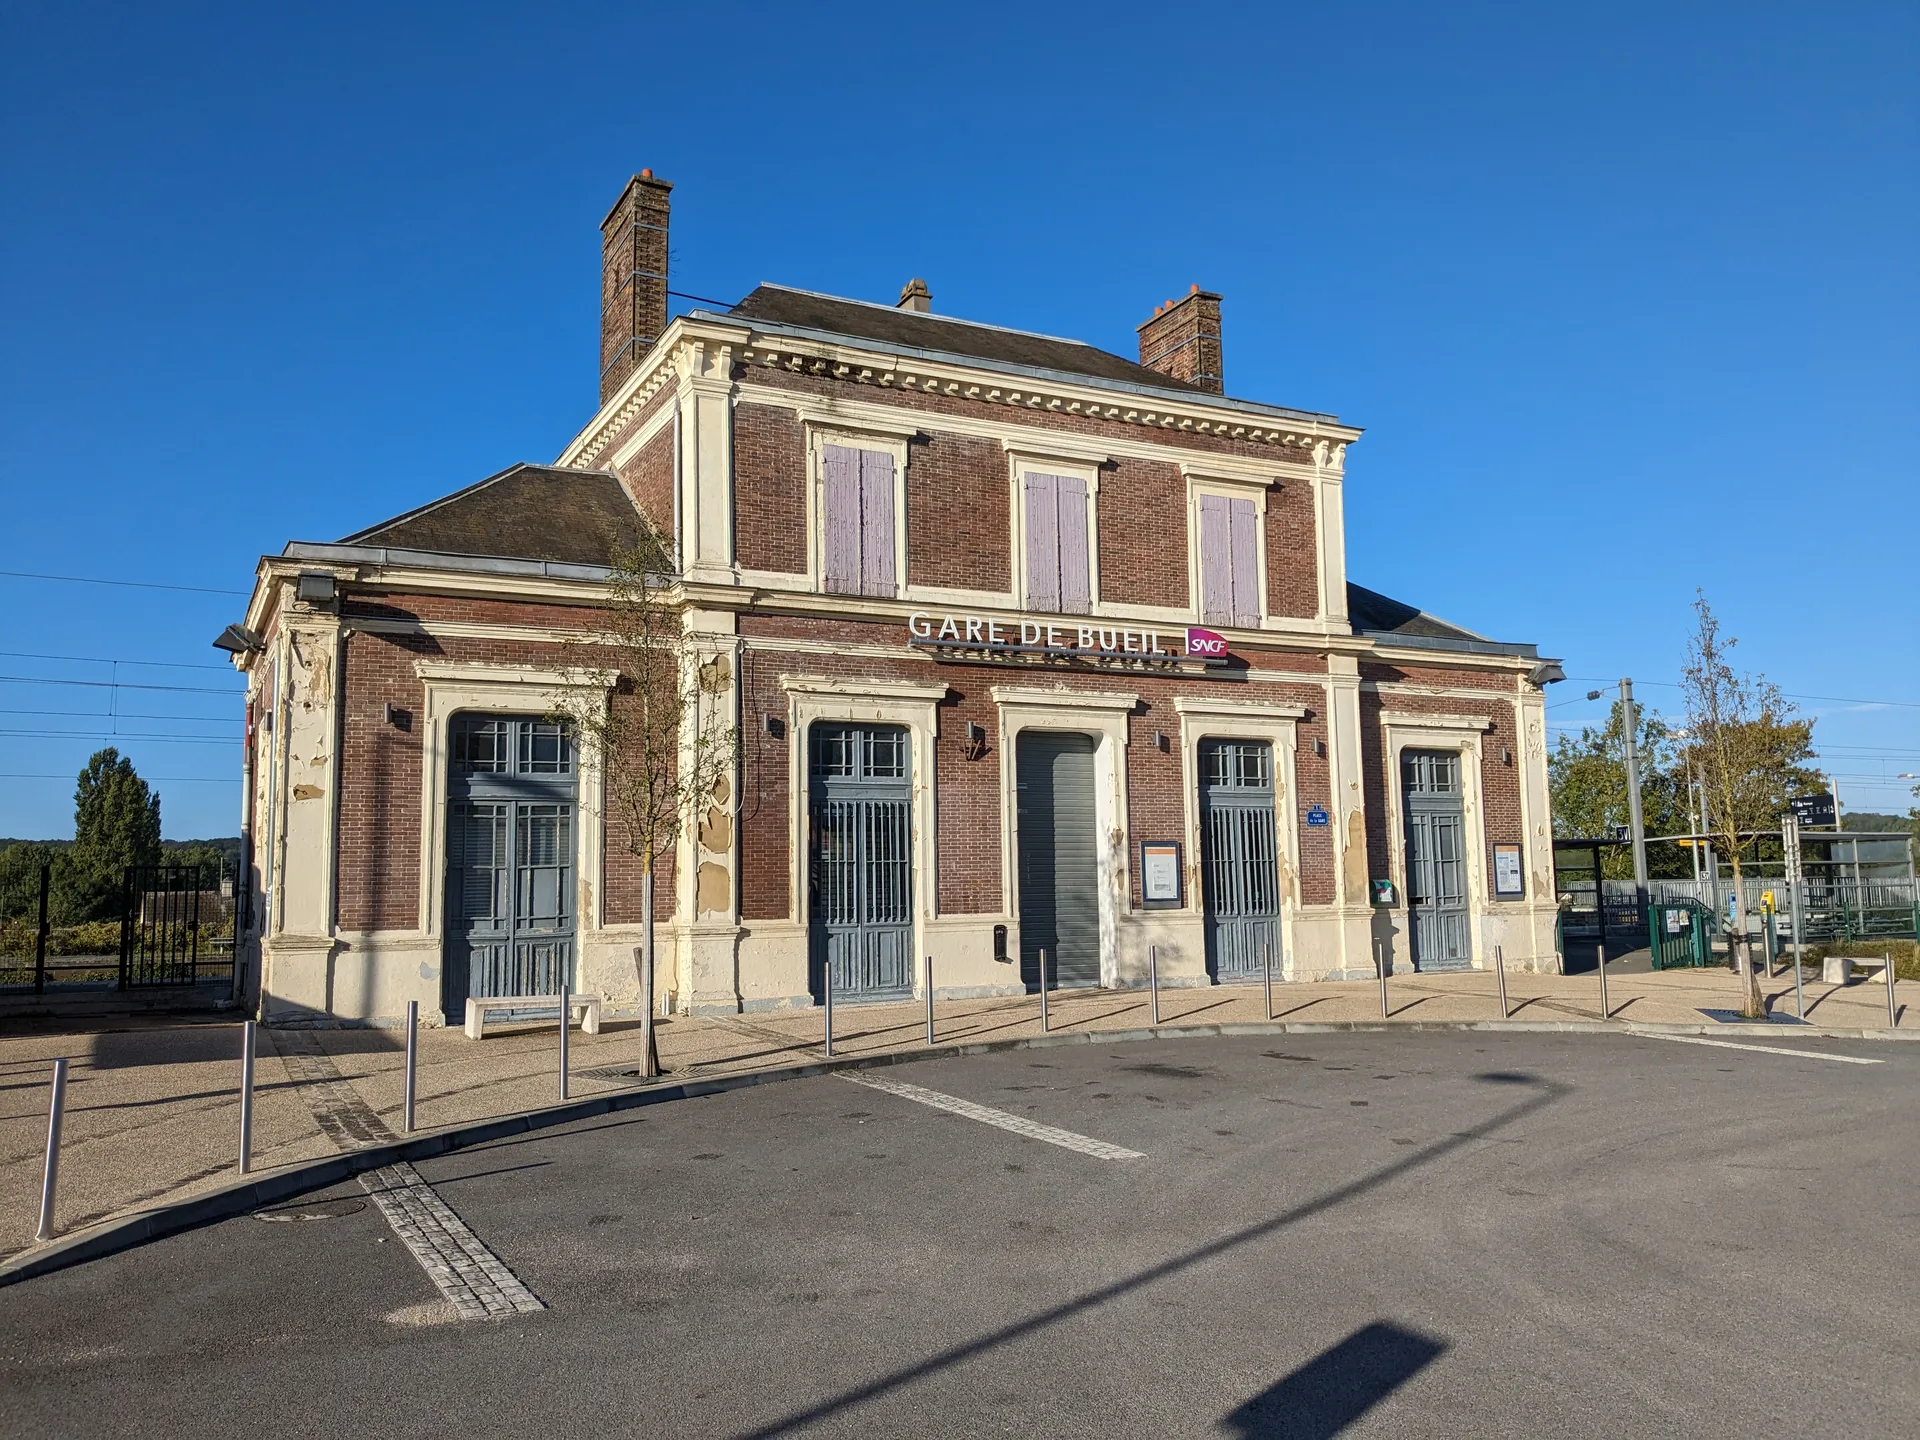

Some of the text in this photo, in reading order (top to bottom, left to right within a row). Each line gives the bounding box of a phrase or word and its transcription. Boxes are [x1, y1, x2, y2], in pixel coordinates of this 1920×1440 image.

[909, 611, 1166, 654] GARE DE BUEIL
[1190, 639, 1226, 652] SNCF
